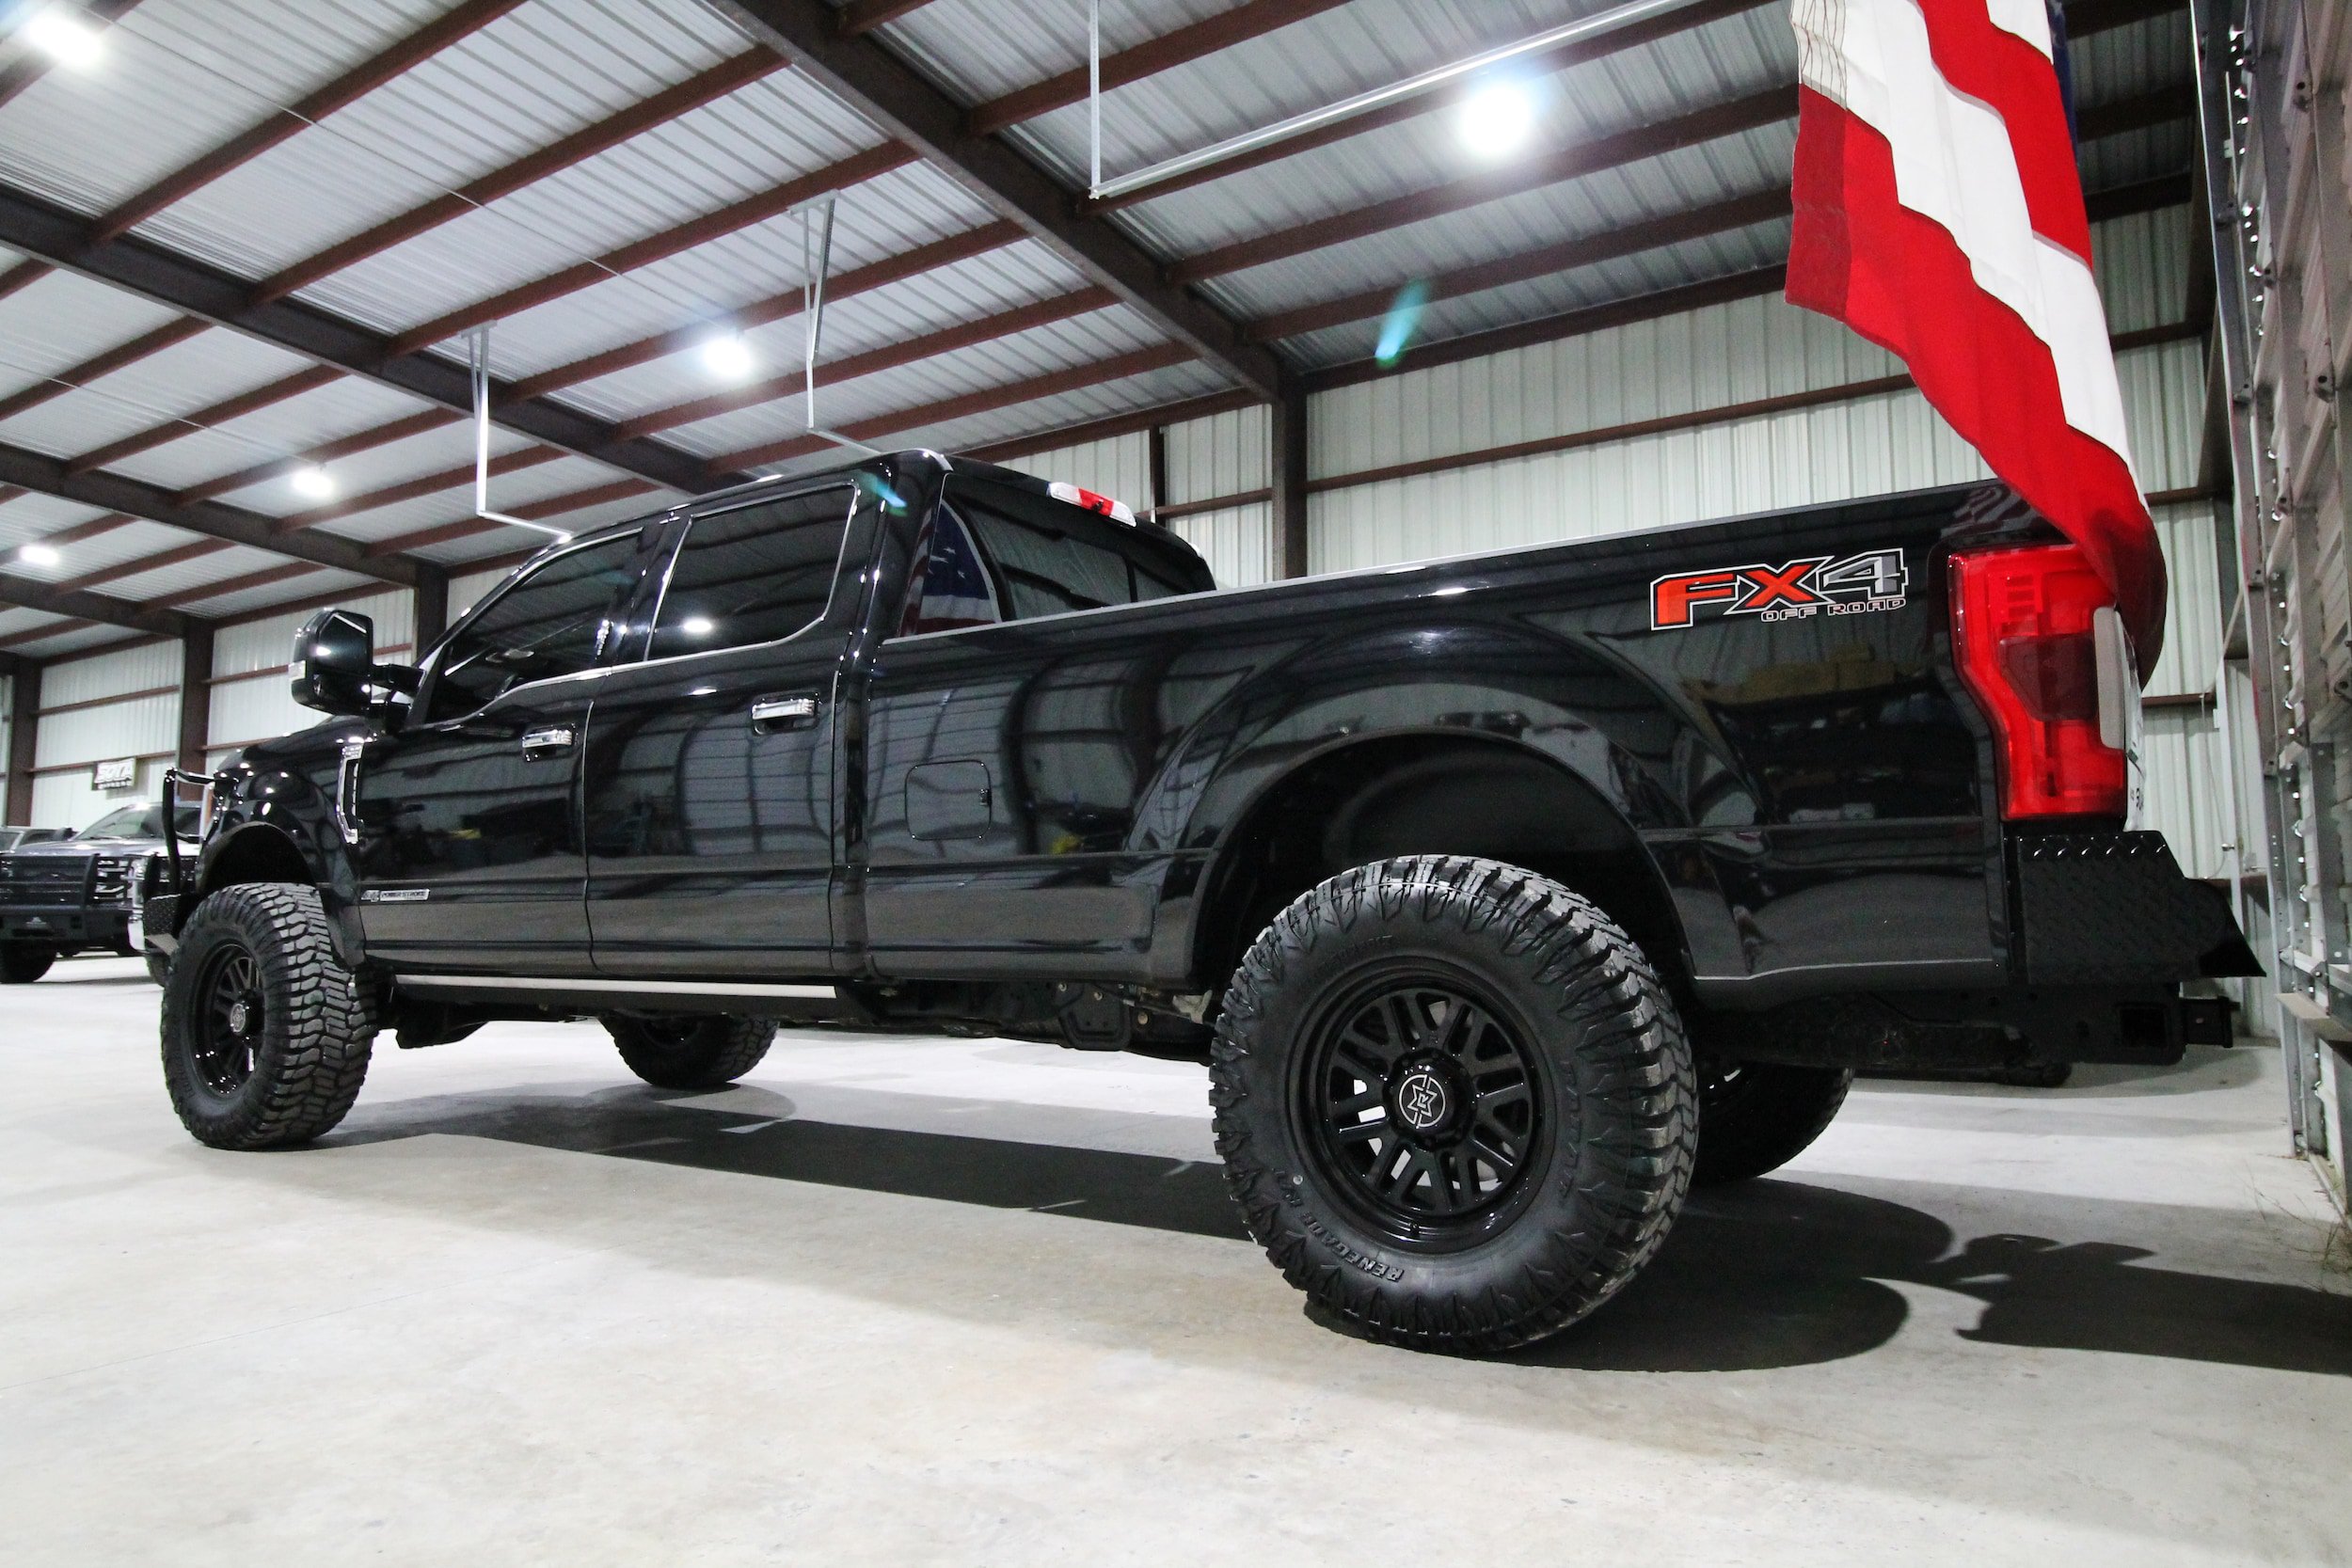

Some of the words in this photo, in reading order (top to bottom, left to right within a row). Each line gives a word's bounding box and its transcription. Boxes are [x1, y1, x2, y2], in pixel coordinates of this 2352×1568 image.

[1650, 547, 1908, 630] FX4
[1760, 606, 1818, 623] OFF
[1827, 597, 1907, 617] ROAD
